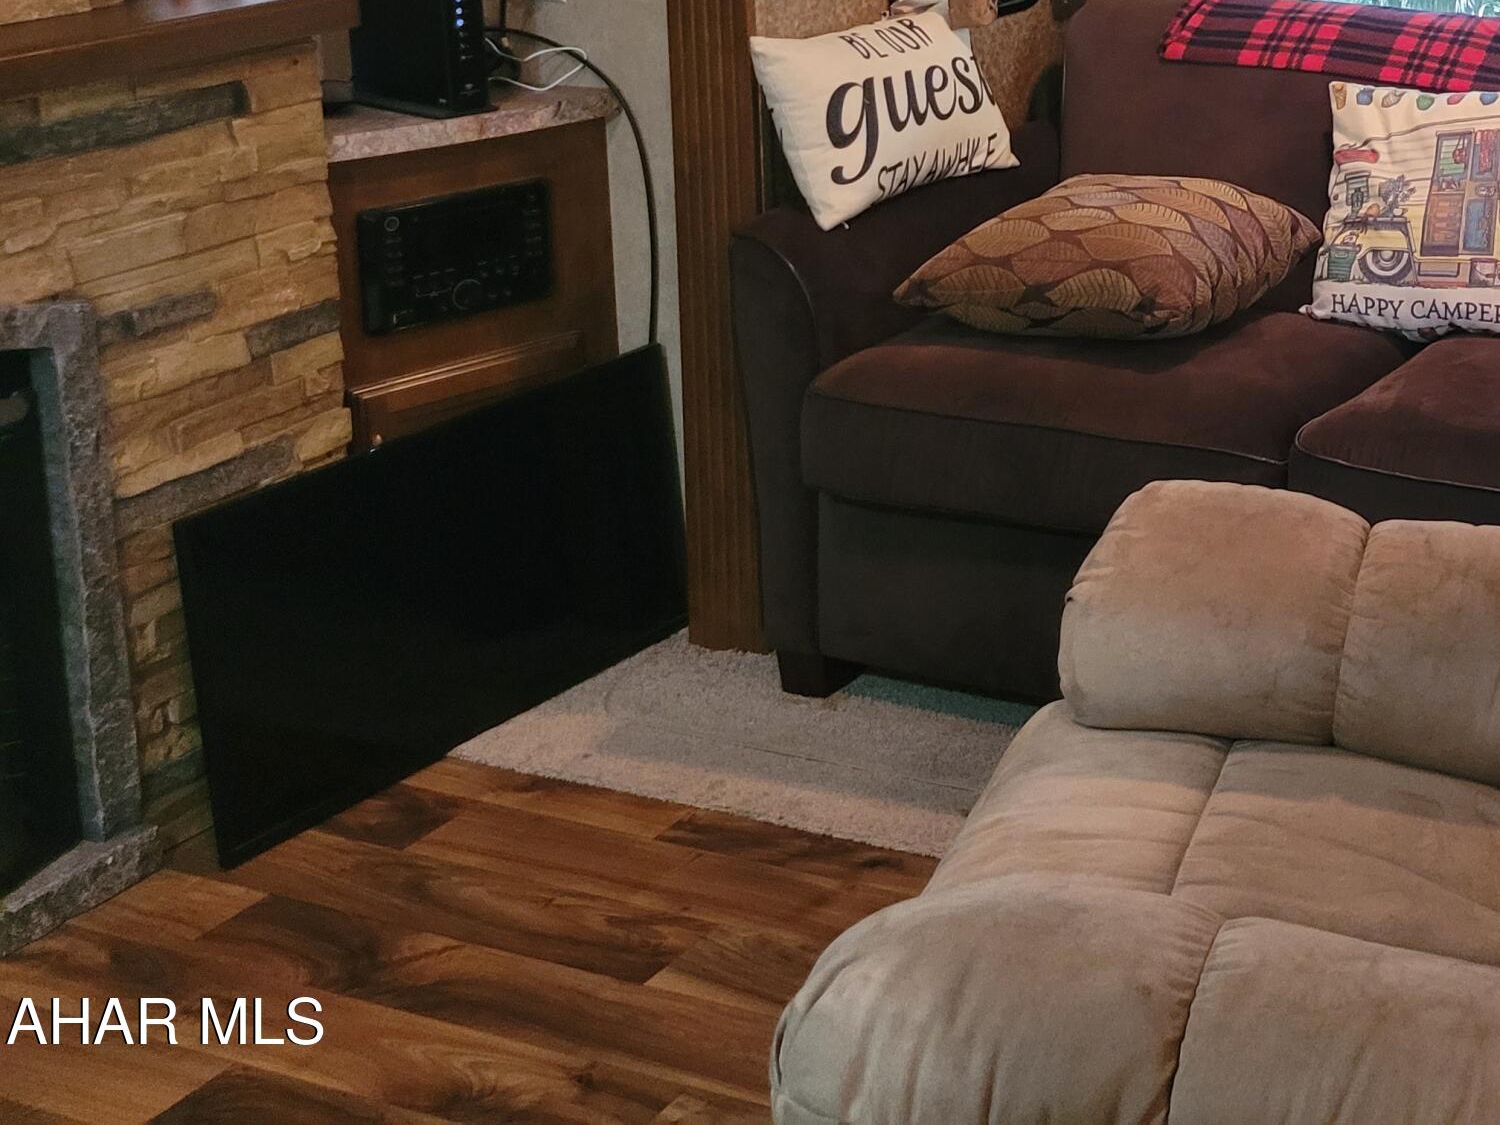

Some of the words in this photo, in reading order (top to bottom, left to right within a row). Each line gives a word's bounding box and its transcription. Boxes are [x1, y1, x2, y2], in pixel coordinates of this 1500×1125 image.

[839, 33, 888, 59] BE
[875, 18, 933, 54] OUR
[877, 151, 927, 203] STAY
[1331, 293, 1403, 318] HAPPY
